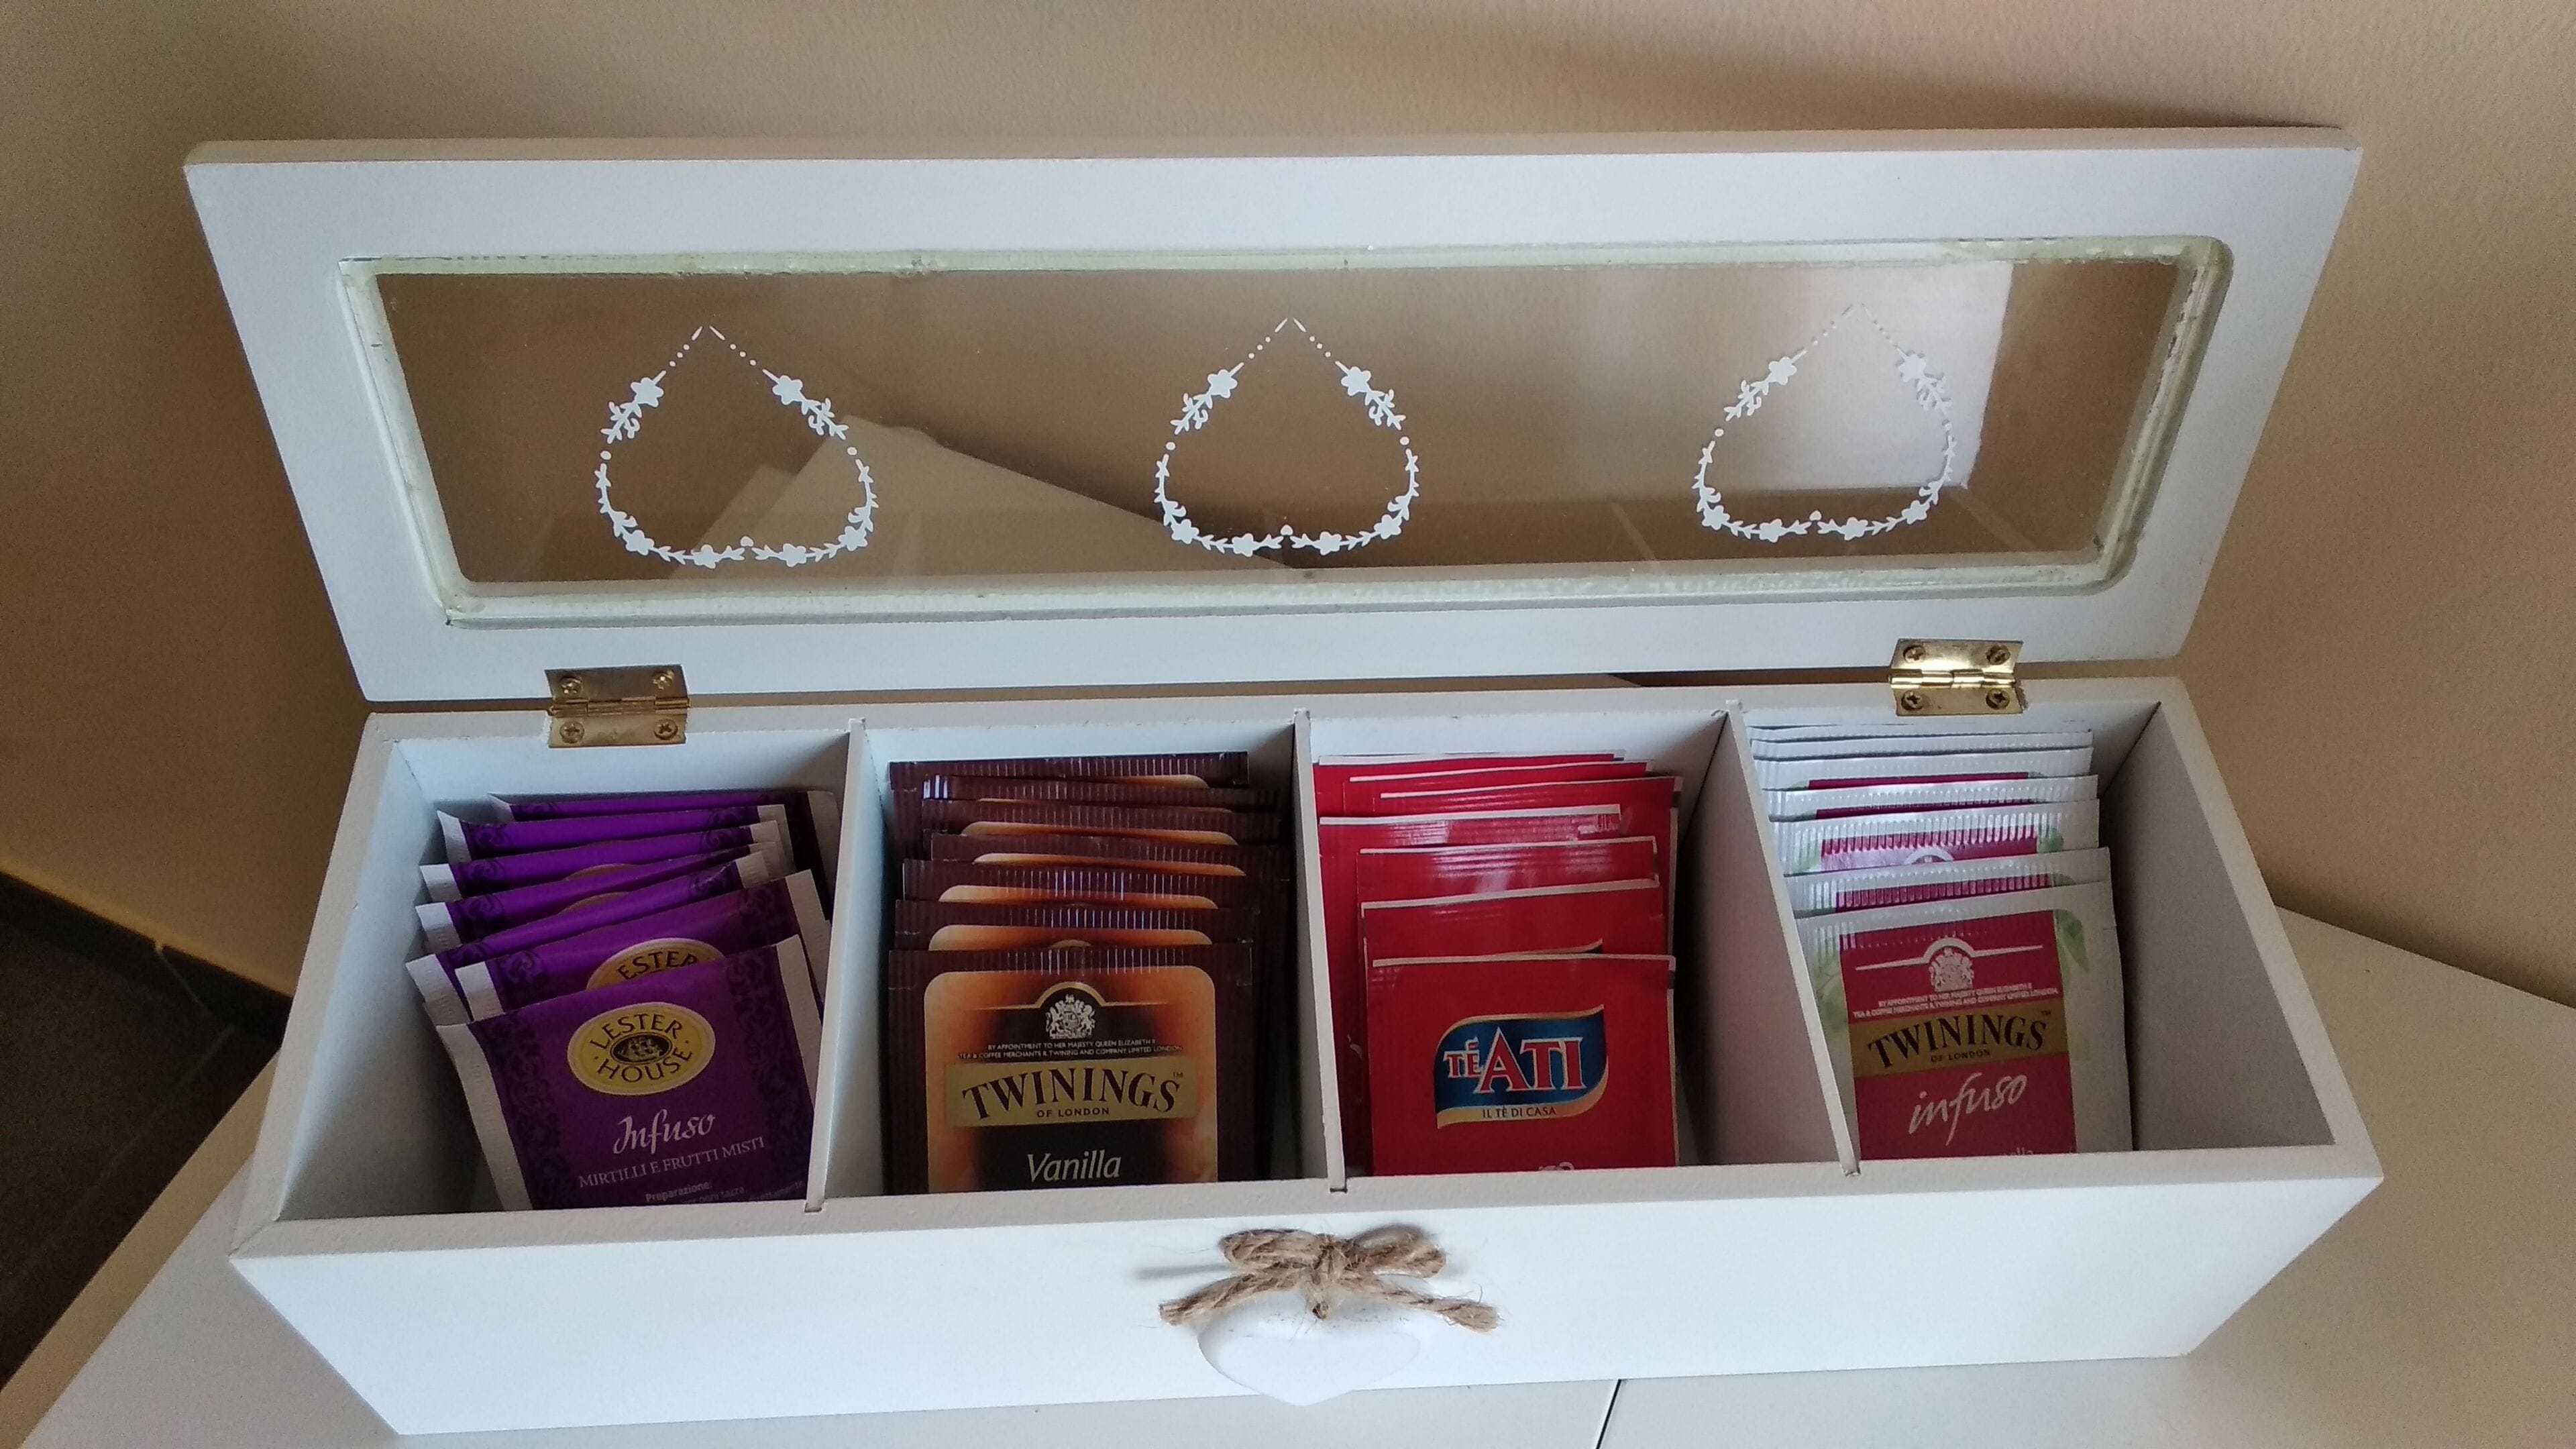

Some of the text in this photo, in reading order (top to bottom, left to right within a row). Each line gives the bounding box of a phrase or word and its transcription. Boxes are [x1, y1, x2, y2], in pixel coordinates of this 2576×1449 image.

[616, 951, 698, 980] ESTER
[590, 1014, 683, 1050] LESTER
[997, 1042, 1041, 1051] APPOINTMENT
[1868, 1013, 2047, 1069] TWININGS
[597, 1047, 692, 1083] HOUSE
[1472, 1026, 1587, 1093] ATI
[1931, 1049, 1990, 1063] OF LONDON
[962, 1067, 1180, 1120] TWININGS
[1909, 1073, 2027, 1146] infuso
[1037, 1107, 1110, 1118] OF LONDON
[1483, 1109, 1493, 1118] IL
[1511, 1107, 1523, 1117] DI
[1526, 1106, 1556, 1117] CASA
[612, 1109, 716, 1155] Infuso
[579, 1136, 766, 1188] MIRTILLI E FRUTTI MISTI
[1027, 1149, 1122, 1183] Vanilla
